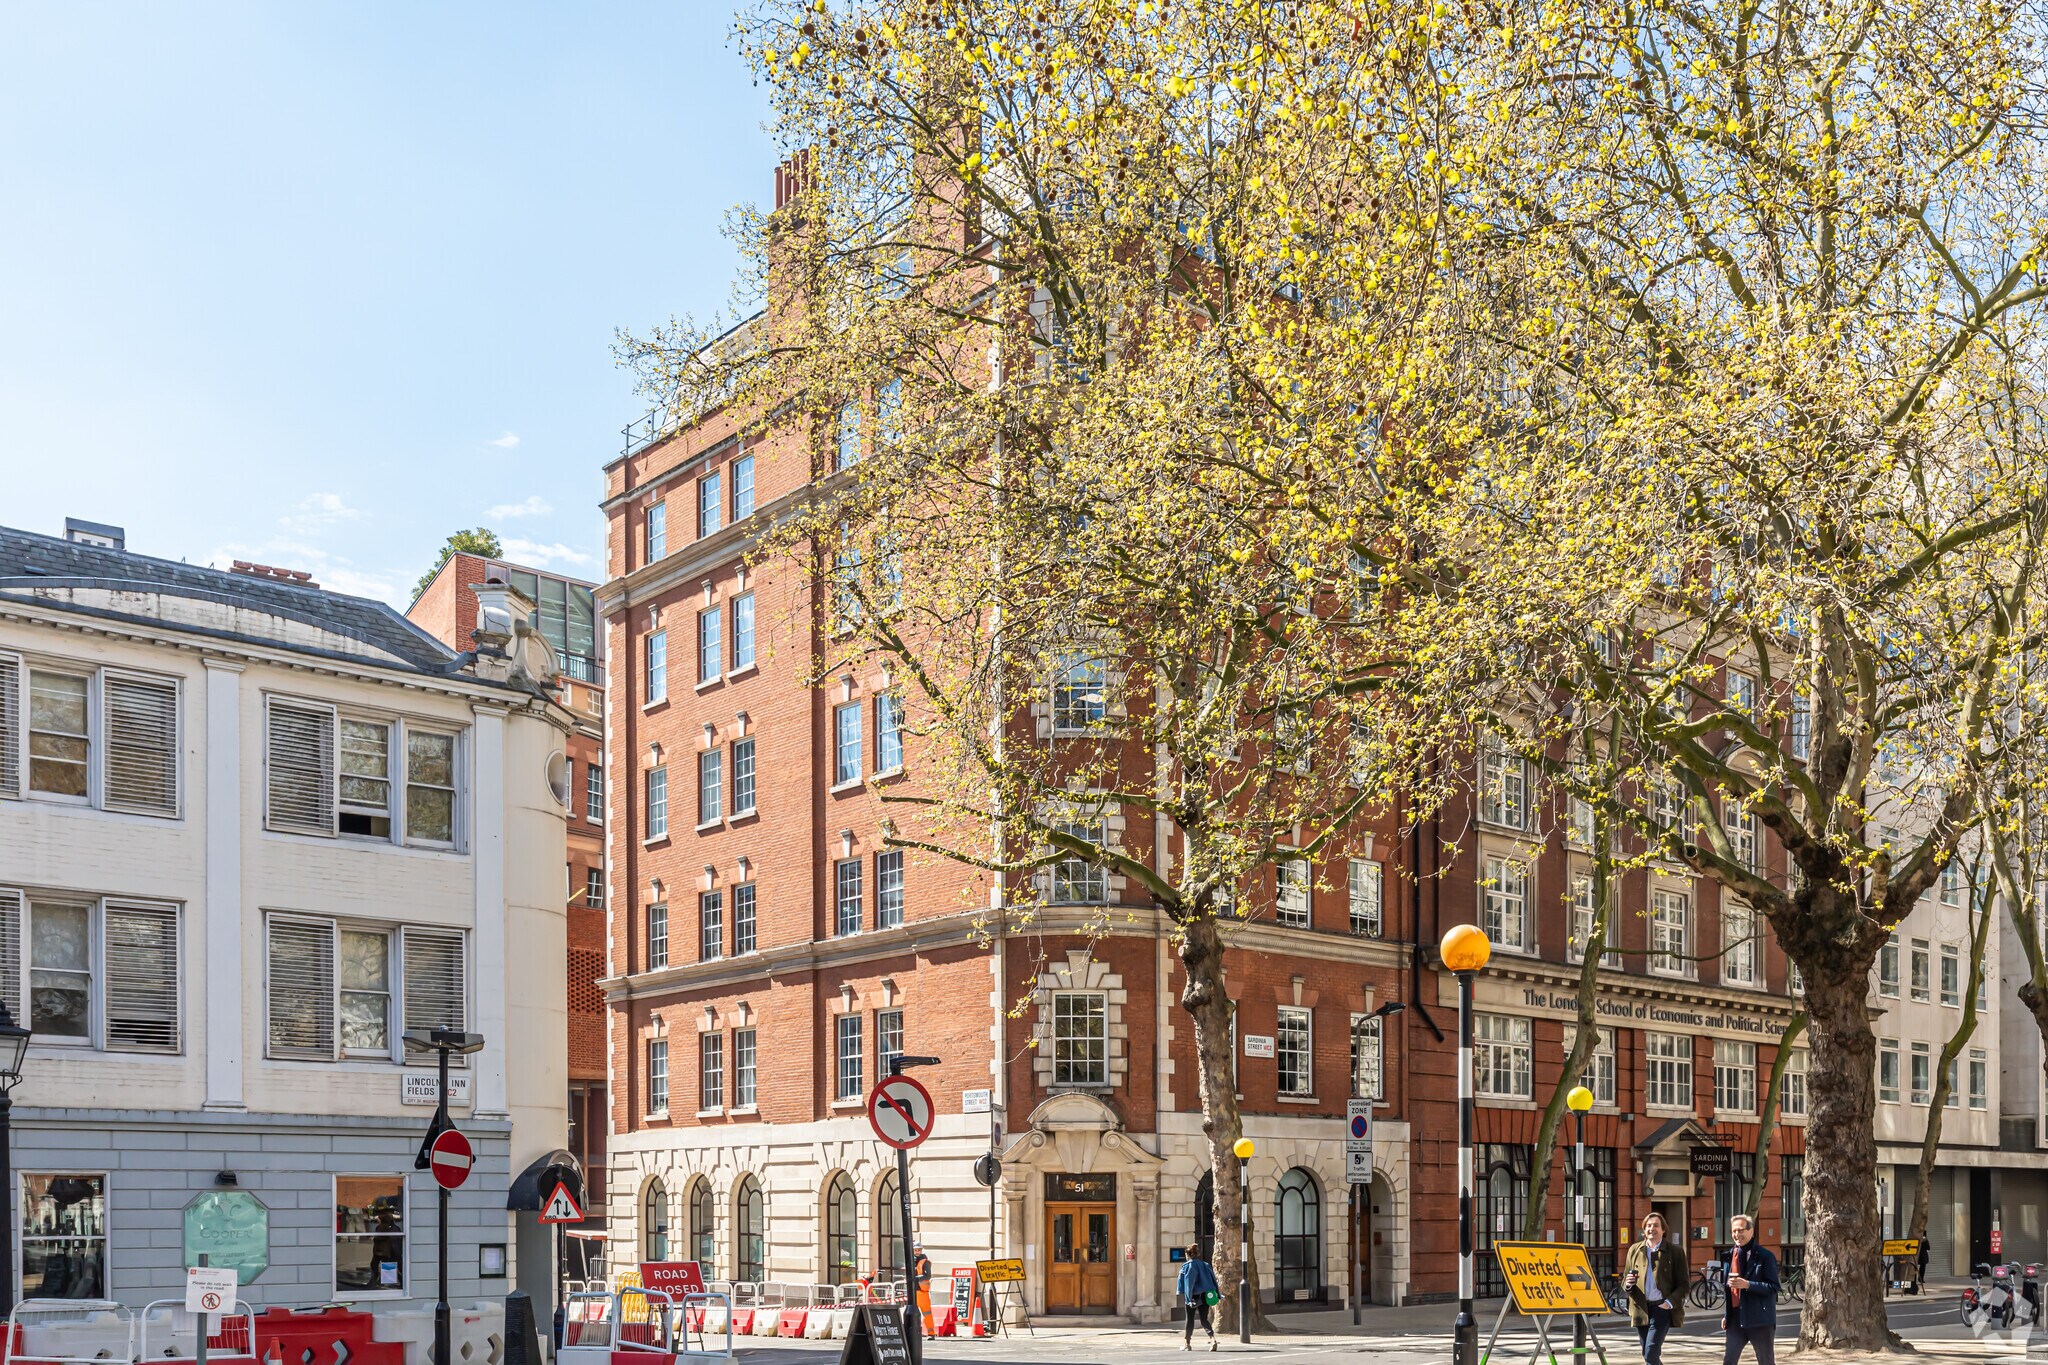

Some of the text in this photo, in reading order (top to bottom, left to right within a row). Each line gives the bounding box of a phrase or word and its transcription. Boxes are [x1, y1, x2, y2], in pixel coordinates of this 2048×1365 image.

[1523, 989, 1787, 1035] The Lond School of Economics and Political Scien
[451, 1079, 466, 1088] INN
[407, 1087, 457, 1097] FIELDS C2
[1694, 1154, 1728, 1162] SARDINIA
[1698, 1164, 1724, 1172] HOUSE
[1074, 1183, 1084, 1193] 51
[979, 1263, 1008, 1272] Diverted
[1506, 1257, 1562, 1276] Diverted
[654, 1270, 688, 1279] ROAD
[985, 1271, 1006, 1280] traffic
[1522, 1281, 1565, 1300] traffic
